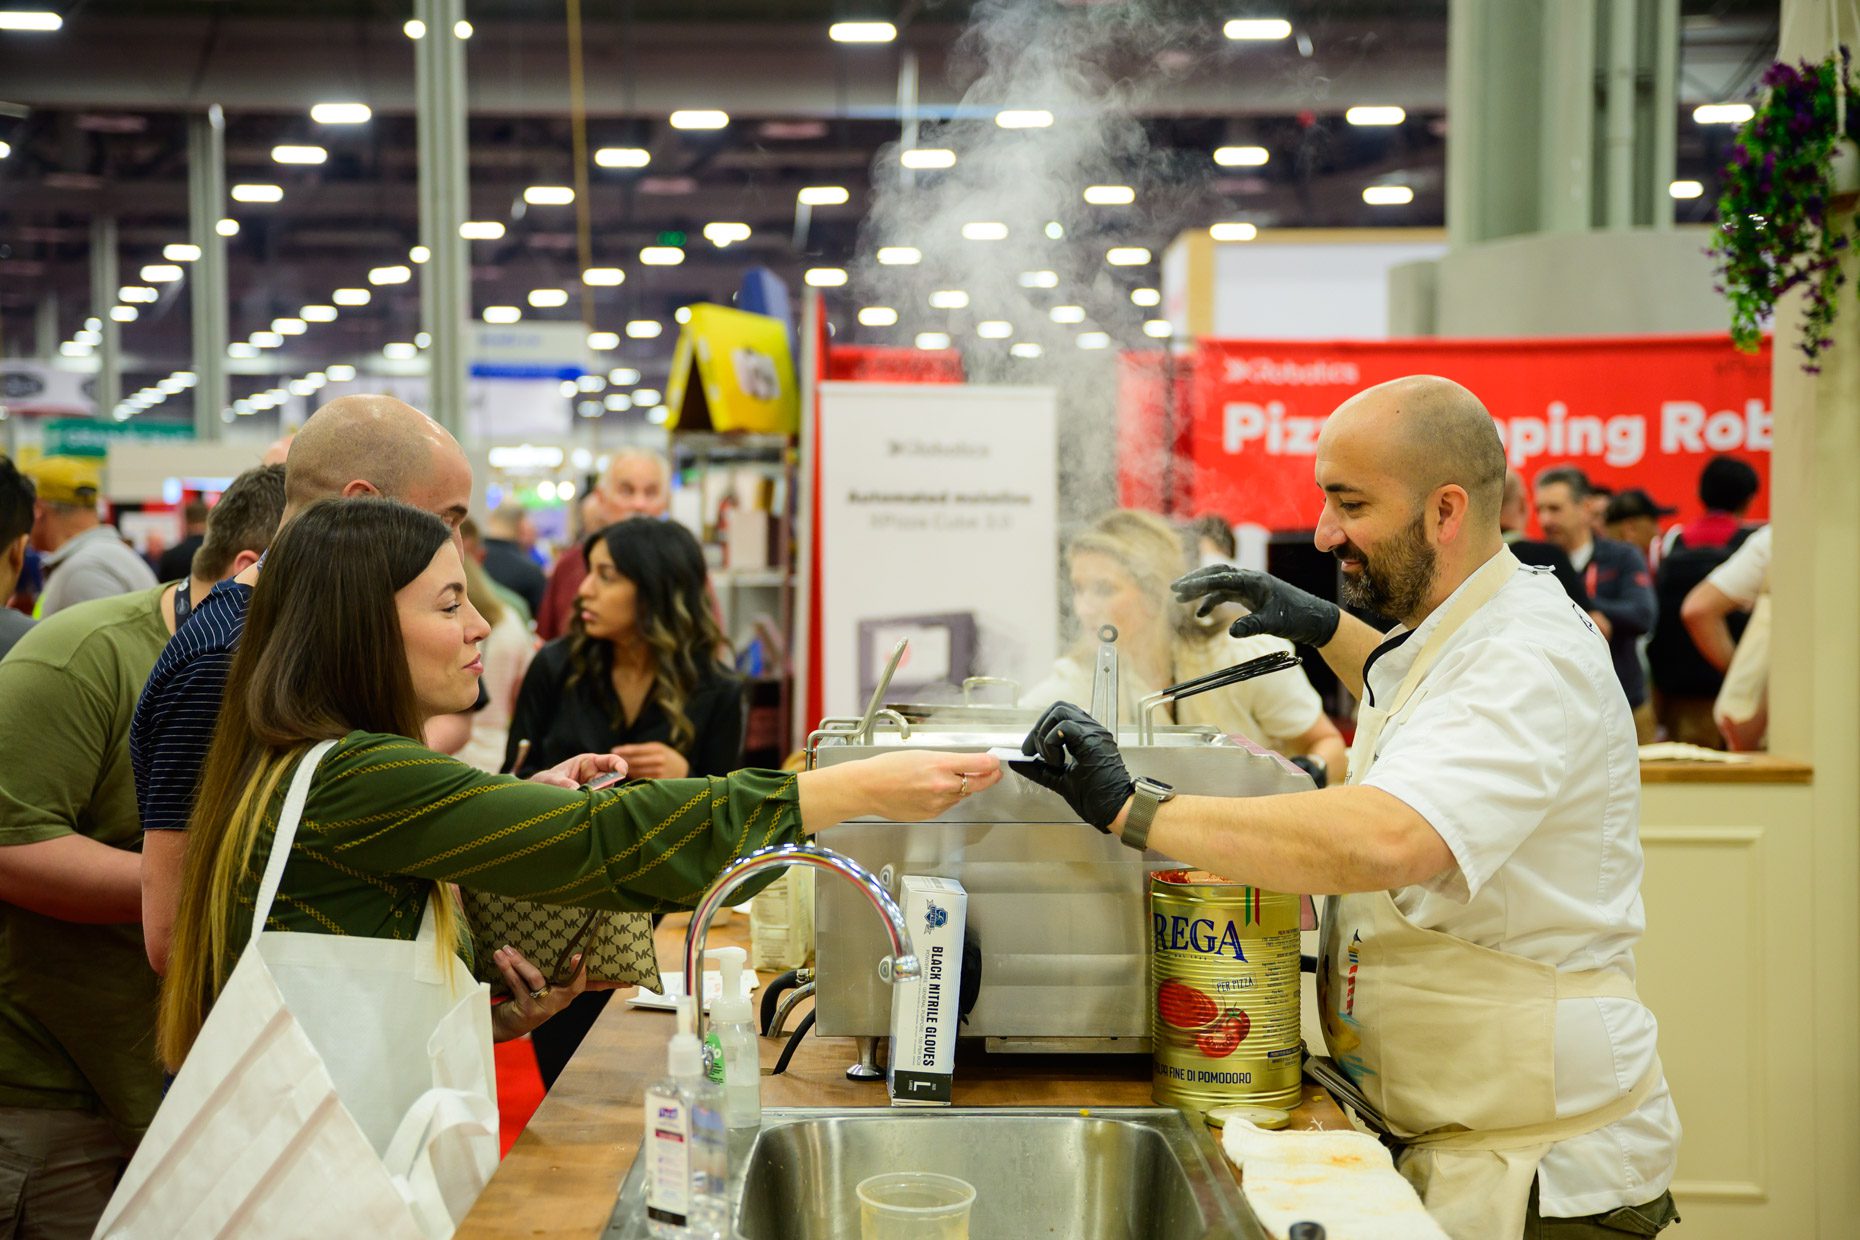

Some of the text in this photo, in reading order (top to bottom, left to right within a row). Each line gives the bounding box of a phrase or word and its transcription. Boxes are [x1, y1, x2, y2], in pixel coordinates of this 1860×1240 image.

[1222, 400, 1330, 456] Piz
[503, 902, 516, 912] MK
[517, 911, 532, 920] MK
[547, 911, 562, 920] MK
[630, 912, 647, 923] MK
[506, 921, 520, 931] MK
[533, 920, 548, 931] MK
[564, 919, 580, 928] MK
[613, 923, 632, 935] MK
[520, 930, 535, 940] MK
[550, 928, 567, 939] MK
[632, 929, 649, 942] MK
[1154, 912, 1249, 963] REGA
[536, 939, 551, 949] MK
[598, 935, 615, 946] MK
[524, 949, 538, 958] MK
[615, 943, 635, 954] MK
[601, 954, 618, 965] MK
[635, 948, 652, 961] MK
[539, 958, 554, 967] MK
[619, 961, 637, 973] MK
[586, 965, 604, 975] MK
[638, 966, 656, 979] MK
[1216, 976, 1254, 992] PER PIZZA
[922, 946, 944, 1067] BLACK NITRILE GLOVES
[1169, 1066, 1185, 1081] FINE
[1187, 1069, 1196, 1082] DI
[1198, 1071, 1252, 1085] POMODORO
[913, 1081, 931, 1091] L
